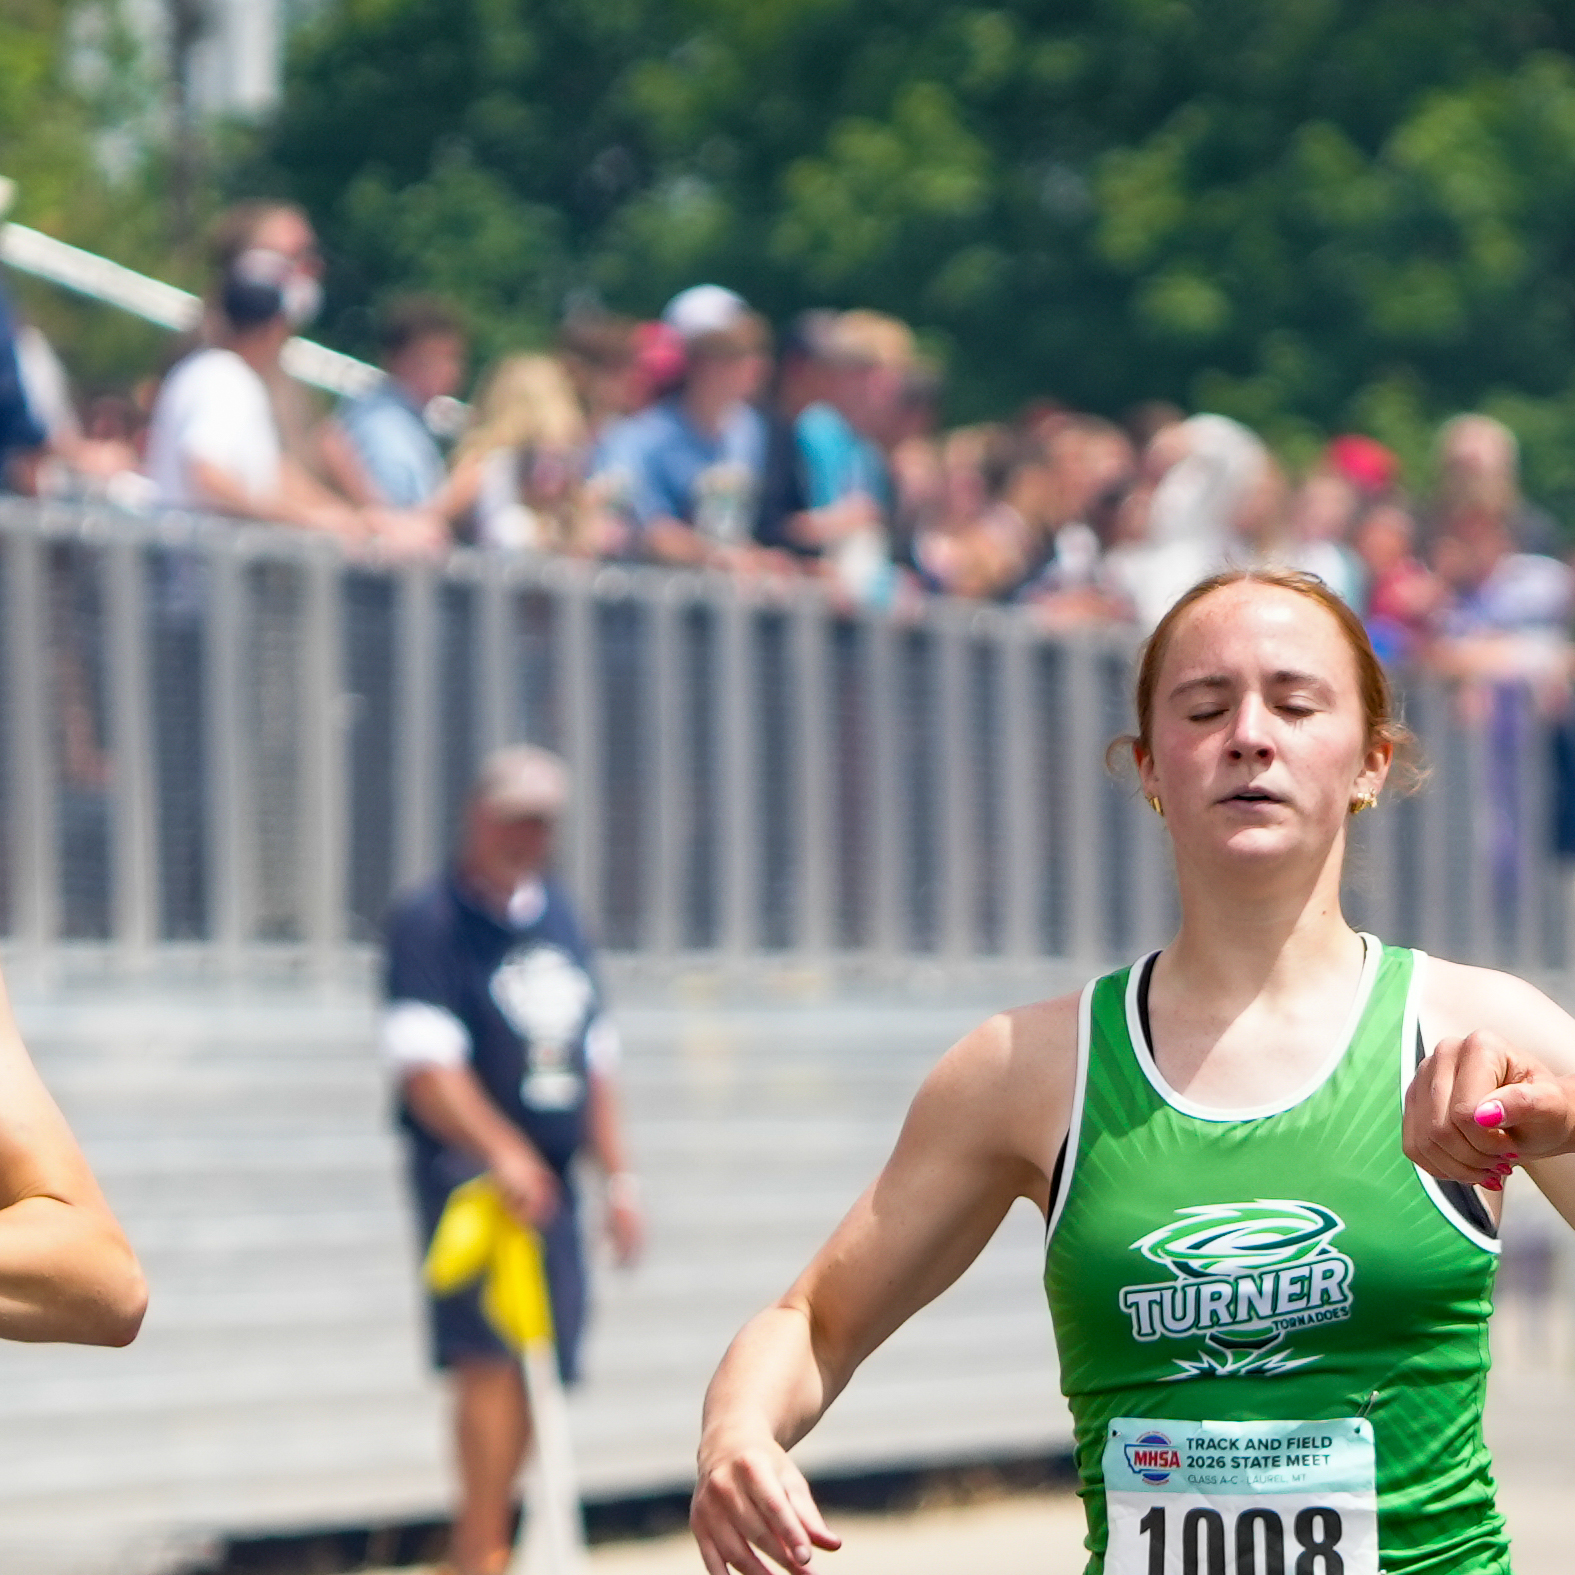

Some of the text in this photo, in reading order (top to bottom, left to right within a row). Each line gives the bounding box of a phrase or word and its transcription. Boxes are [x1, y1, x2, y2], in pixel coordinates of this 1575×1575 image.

[1124, 1256, 1349, 1337] TURNER
[1271, 1306, 1349, 1331] TORNADOES
[1186, 1437, 1240, 1451] TRACK
[1244, 1437, 1282, 1451] AND
[1286, 1436, 1333, 1450] FIELD
[1134, 1450, 1181, 1468] MHSA
[1186, 1454, 1330, 1469] 2026 STATE MEET
[1187, 1474, 1217, 1484] CLASS
[1220, 1475, 1238, 1485] A-C
[1292, 1474, 1306, 1482] MT
